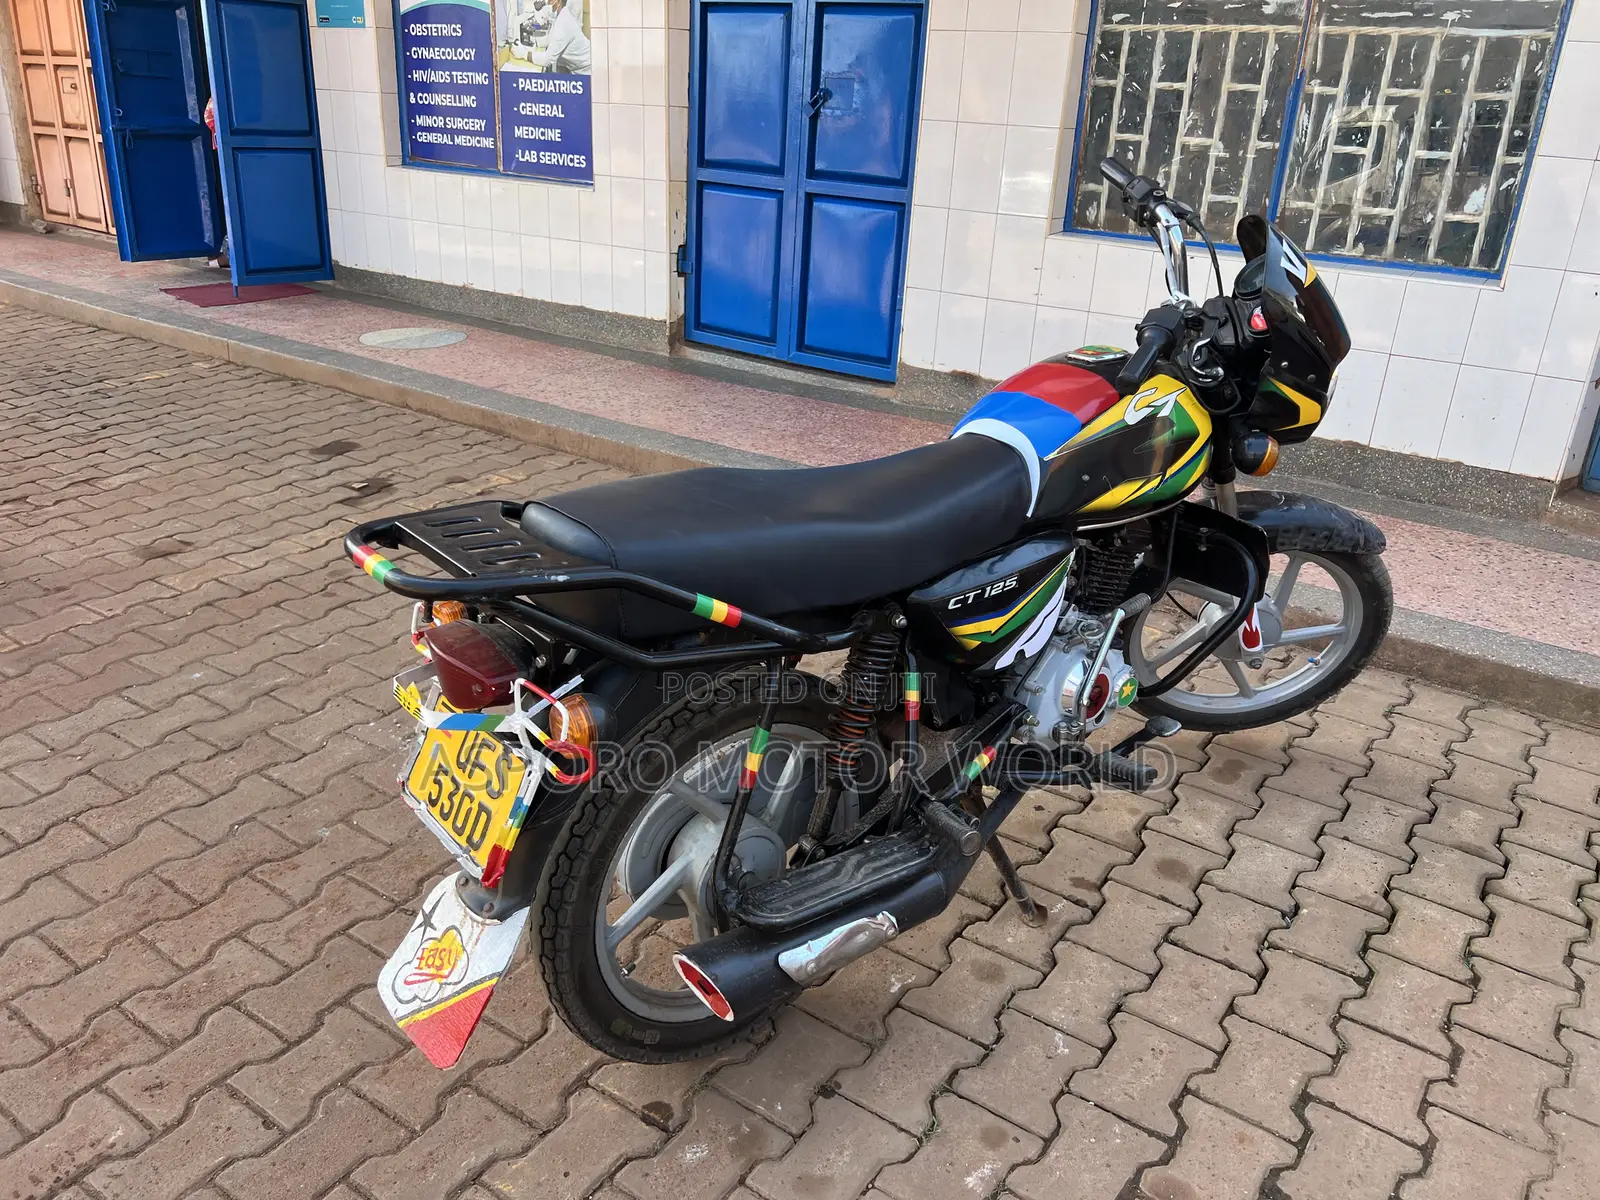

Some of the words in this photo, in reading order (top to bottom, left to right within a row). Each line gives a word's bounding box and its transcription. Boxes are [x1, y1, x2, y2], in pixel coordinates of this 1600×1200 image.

[409, 23, 463, 37] OBSTETRICS
[411, 47, 476, 61] GYNAECOLOGY
[412, 69, 451, 84] HIV/AIDS
[451, 71, 489, 86] TESTING
[518, 77, 584, 95] PAEDIATRICS
[409, 92, 416, 104] &
[416, 93, 477, 108] COUNSELLING
[519, 102, 565, 118] GENERAL
[415, 115, 445, 128] MINOR
[446, 117, 487, 132] SURGERY
[416, 131, 454, 146] GENERAL
[454, 134, 495, 149] MEDICINE
[514, 125, 562, 142] MEDICINE
[539, 151, 587, 168] SERVICES
[948, 590, 982, 610] CT
[984, 576, 1018, 598] 125
[456, 730, 513, 799] UFS
[427, 762, 492, 851] 530D
